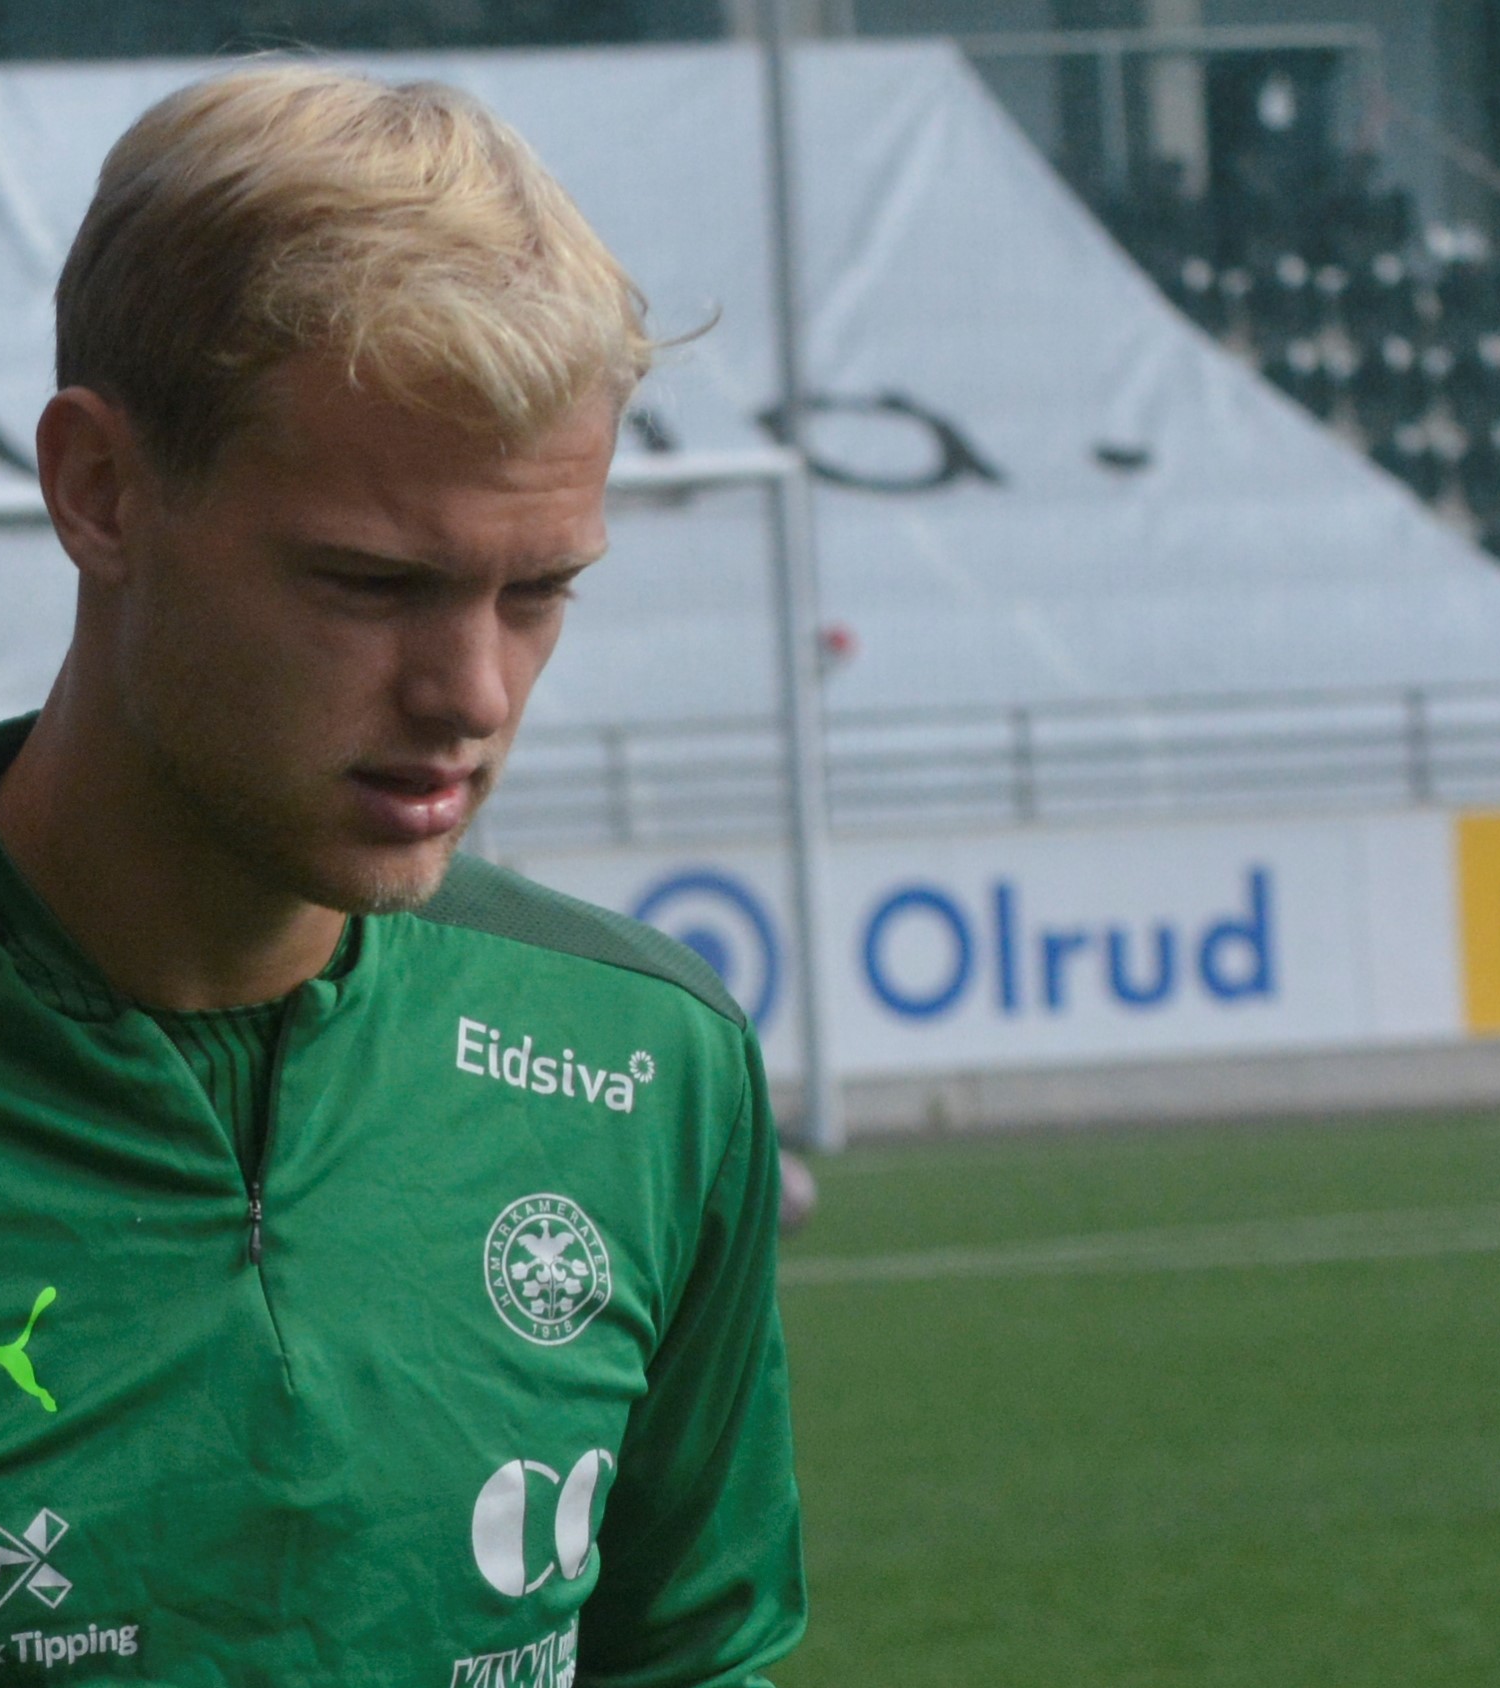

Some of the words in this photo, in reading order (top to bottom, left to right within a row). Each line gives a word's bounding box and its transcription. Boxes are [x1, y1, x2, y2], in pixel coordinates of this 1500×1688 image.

[864, 868, 1273, 1017] Olrud
[456, 1016, 635, 1114] Eidsiva
[490, 1199, 607, 1309] HAMARKAMERATENE
[532, 1320, 574, 1337] 1918
[10, 1623, 139, 1668] Tipping
